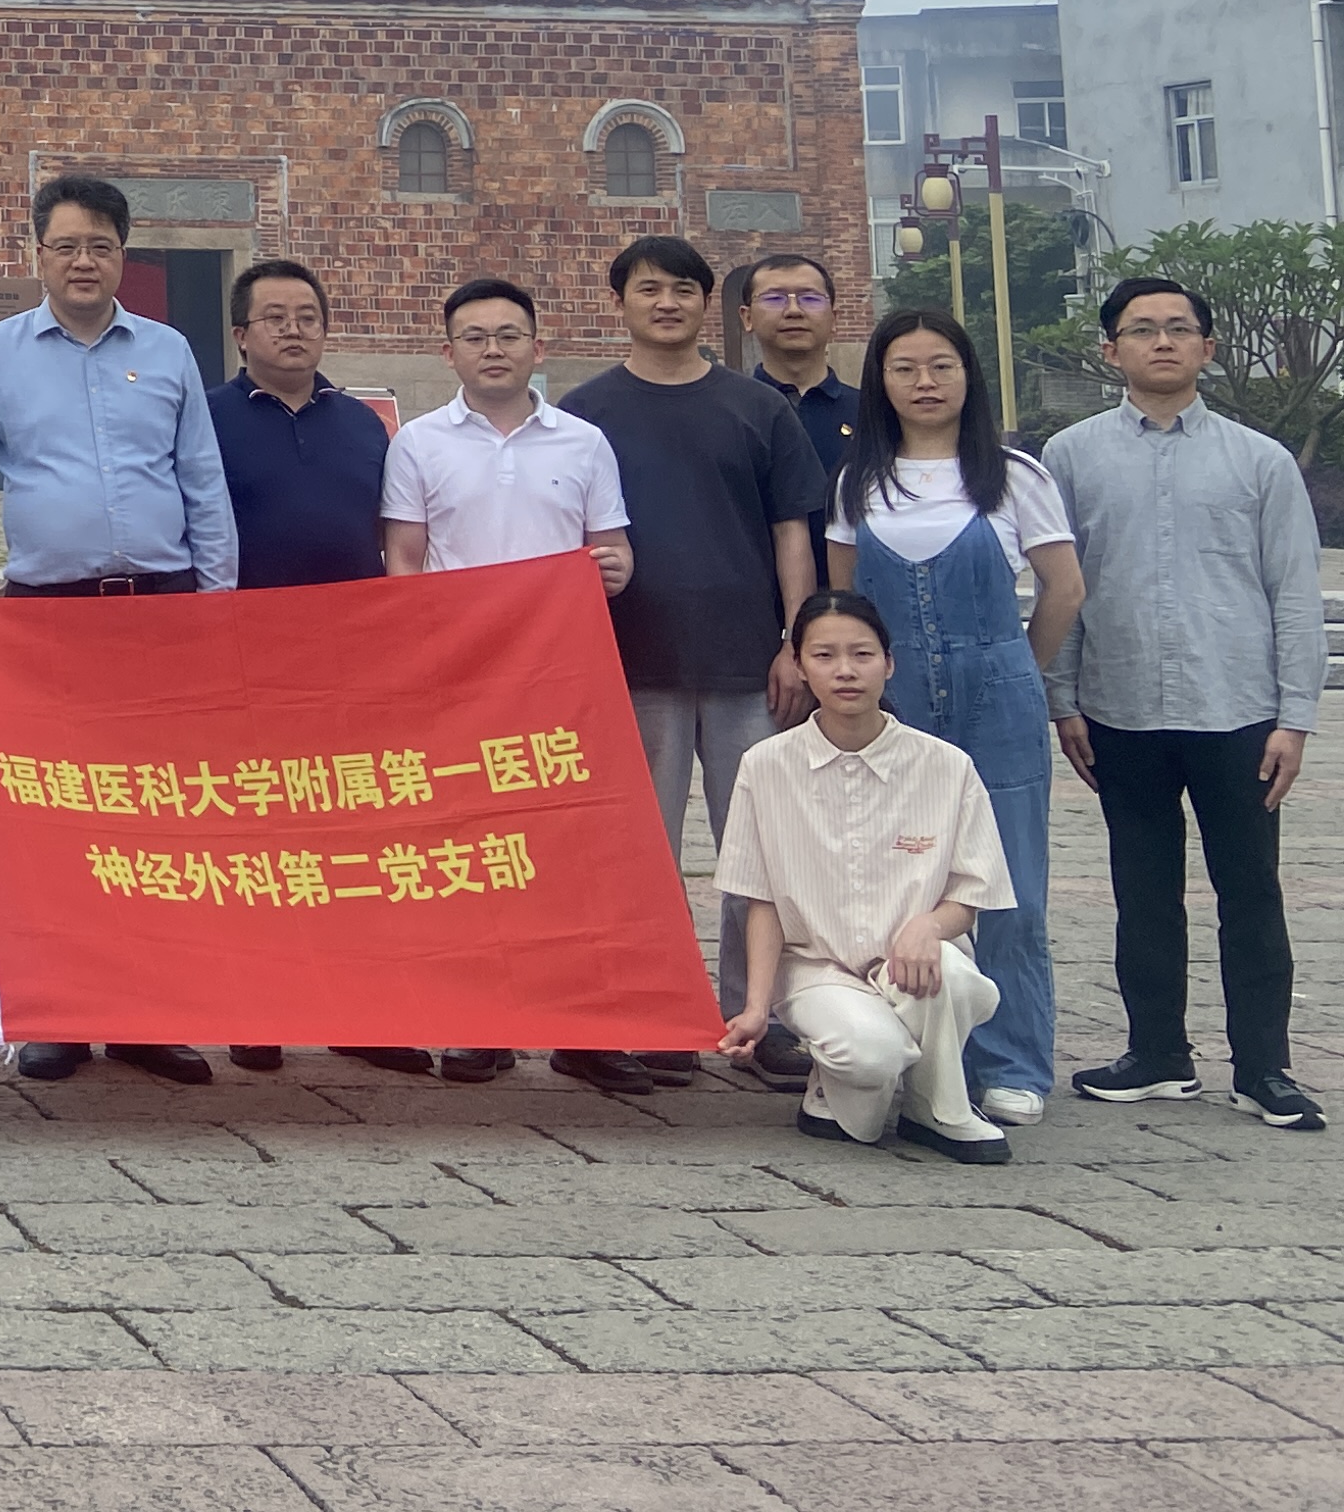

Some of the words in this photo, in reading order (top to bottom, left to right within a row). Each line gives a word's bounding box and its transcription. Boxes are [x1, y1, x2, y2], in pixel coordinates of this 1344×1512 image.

[85, 833, 536, 908] 神经外科第二党支部
